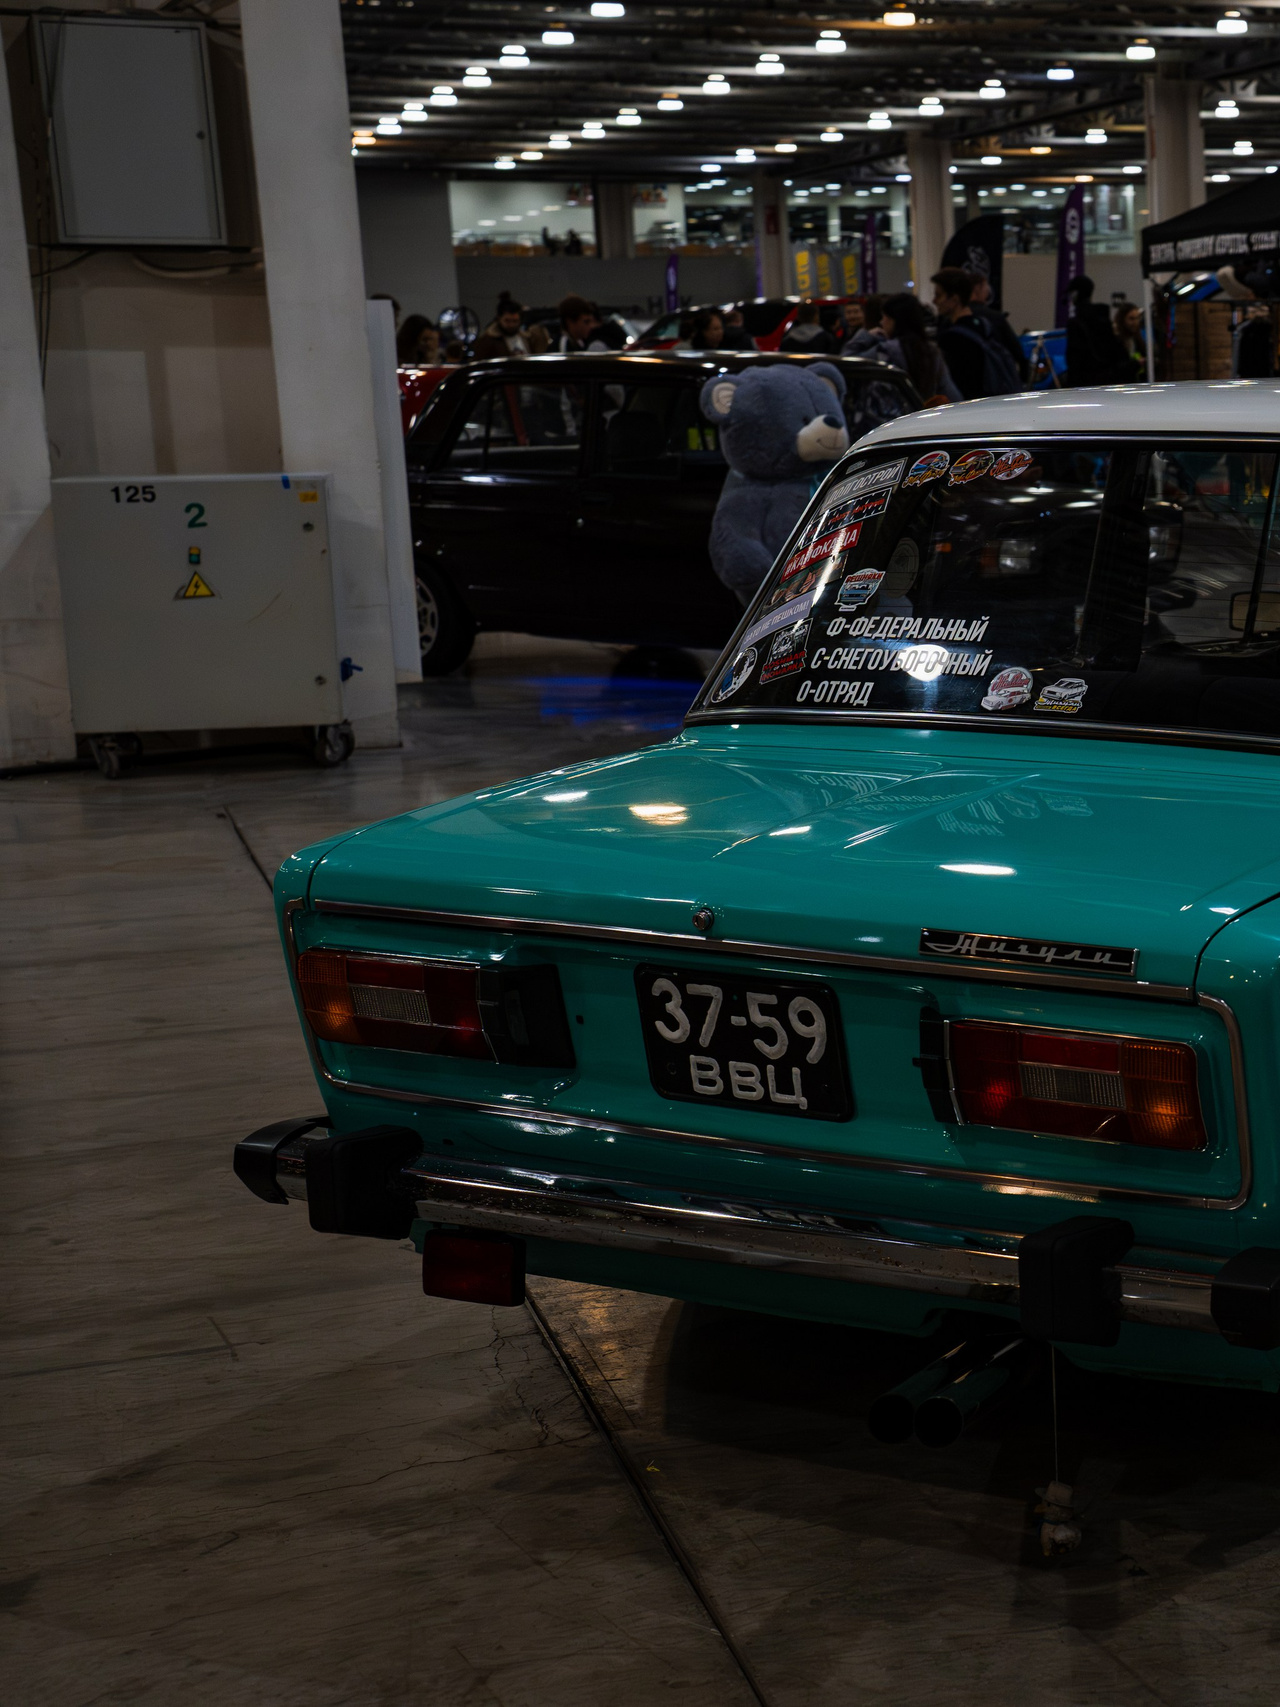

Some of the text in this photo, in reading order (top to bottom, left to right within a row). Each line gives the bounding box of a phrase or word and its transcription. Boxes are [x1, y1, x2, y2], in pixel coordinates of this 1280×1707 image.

[111, 485, 157, 503] 125
[185, 503, 208, 528] 2
[826, 616, 990, 643] Ф-ФЕДЕРАЛЬНЫЙ
[810, 647, 994, 677] С-СНЕГОУБОРОЧНЫЙ
[796, 680, 874, 707] О-ОТРЯД
[924, 934, 1131, 967] Жигули
[651, 977, 828, 1065] 37-59
[689, 1053, 808, 1111] ВВЦ
